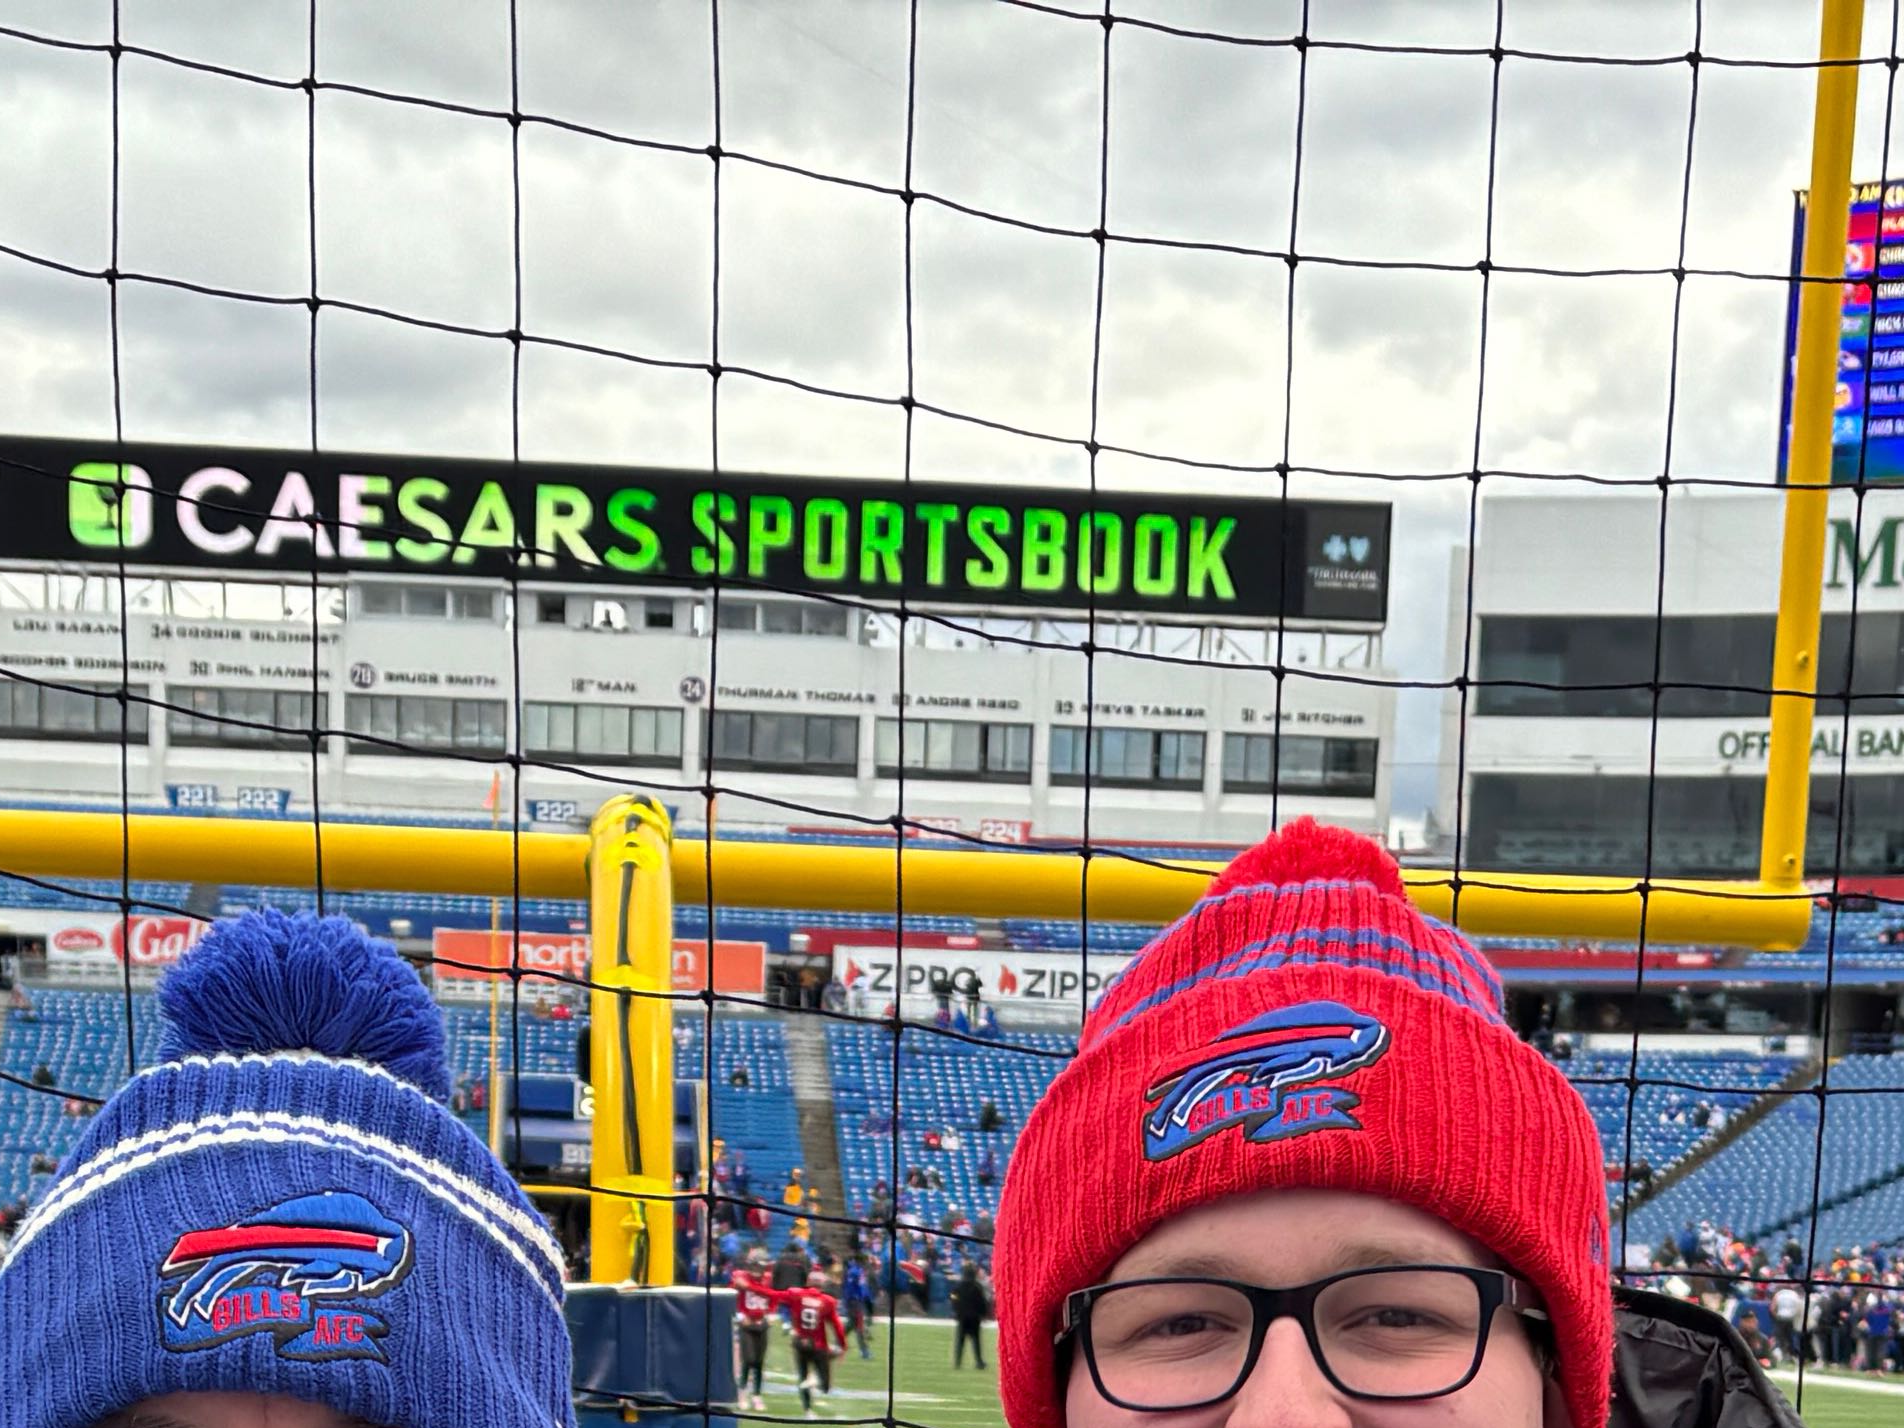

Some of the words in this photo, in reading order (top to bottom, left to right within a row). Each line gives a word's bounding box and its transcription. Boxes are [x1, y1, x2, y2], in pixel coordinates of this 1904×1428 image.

[176, 465, 660, 574] CAESARS
[691, 489, 1238, 601] SPORTSBOOK
[536, 801, 576, 822] 222
[982, 821, 1021, 842] 224
[212, 1290, 302, 1333] BILLS
[312, 1315, 366, 1345] AFC
